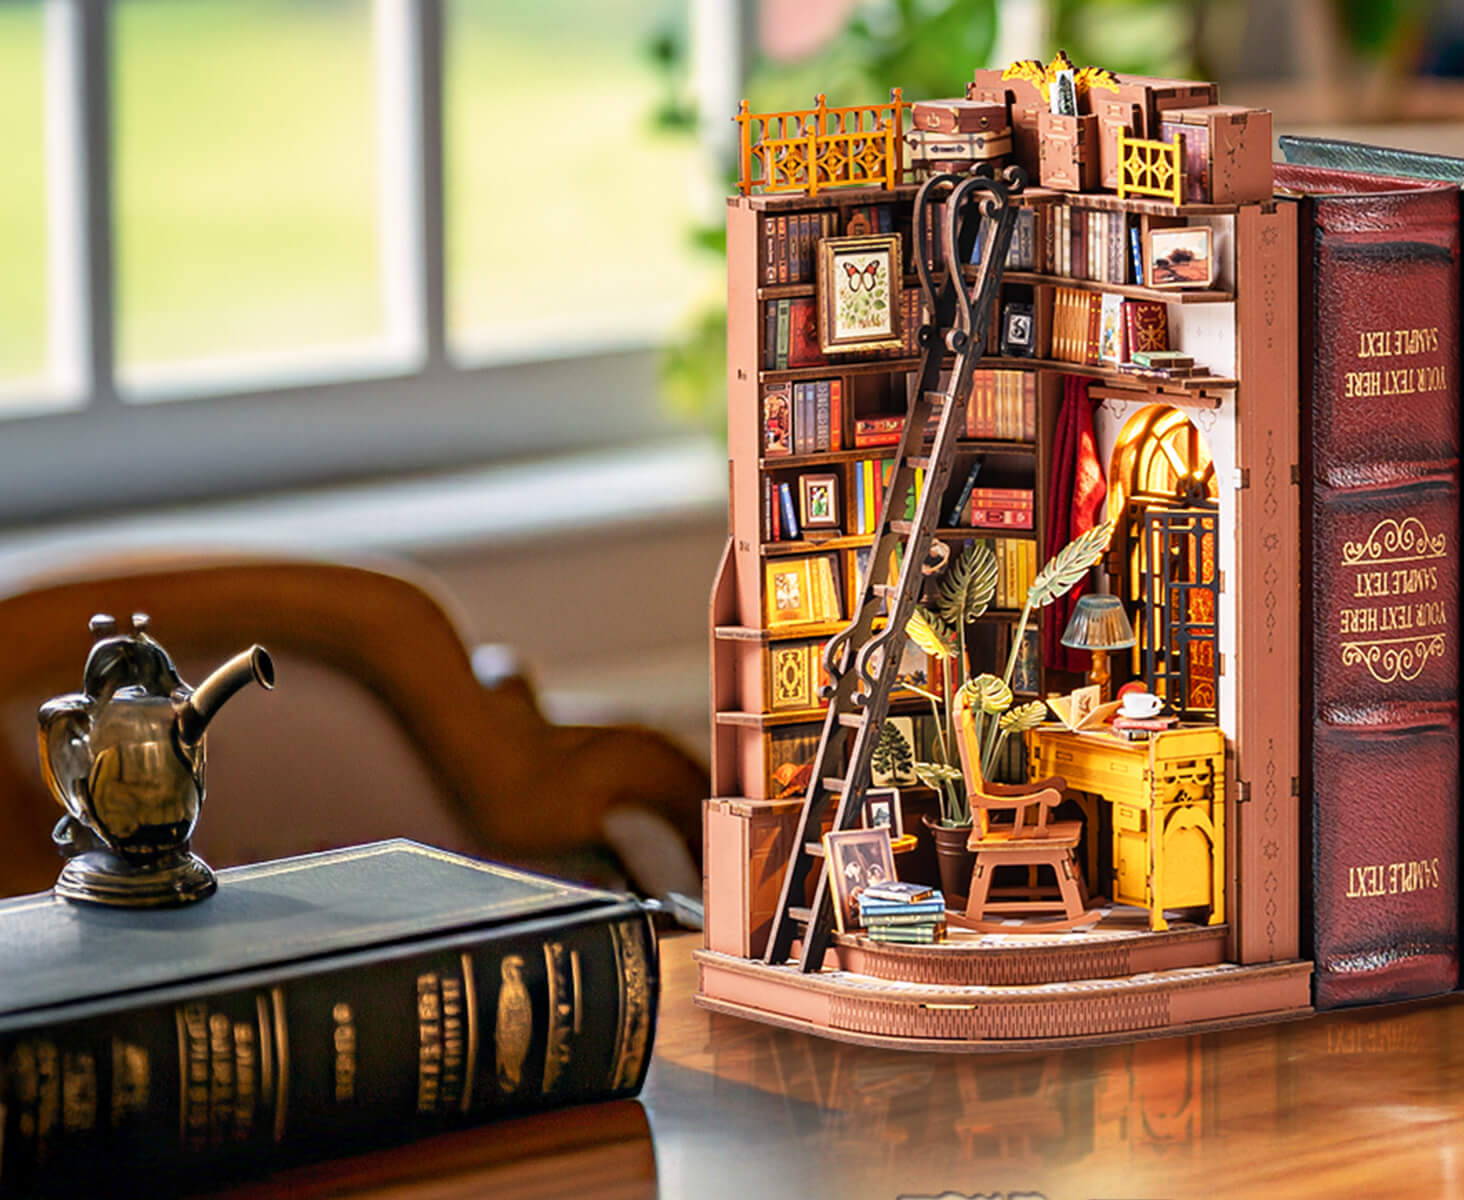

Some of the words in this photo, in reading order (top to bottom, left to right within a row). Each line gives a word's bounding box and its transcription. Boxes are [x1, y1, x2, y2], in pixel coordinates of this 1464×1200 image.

[1358, 331, 1392, 358] TEXT
[1394, 327, 1438, 355] SAMPLE
[1344, 371, 1381, 398] HERE
[1383, 368, 1415, 395] TEXT
[1354, 571, 1390, 598] TEXT
[1391, 566, 1438, 595] SAMPLE
[1340, 608, 1378, 634] HERE
[1380, 605, 1414, 631] TEXT
[1415, 601, 1447, 627] YOUR
[1346, 865, 1386, 898] TEXT
[1388, 857, 1440, 894] SAMPLE
